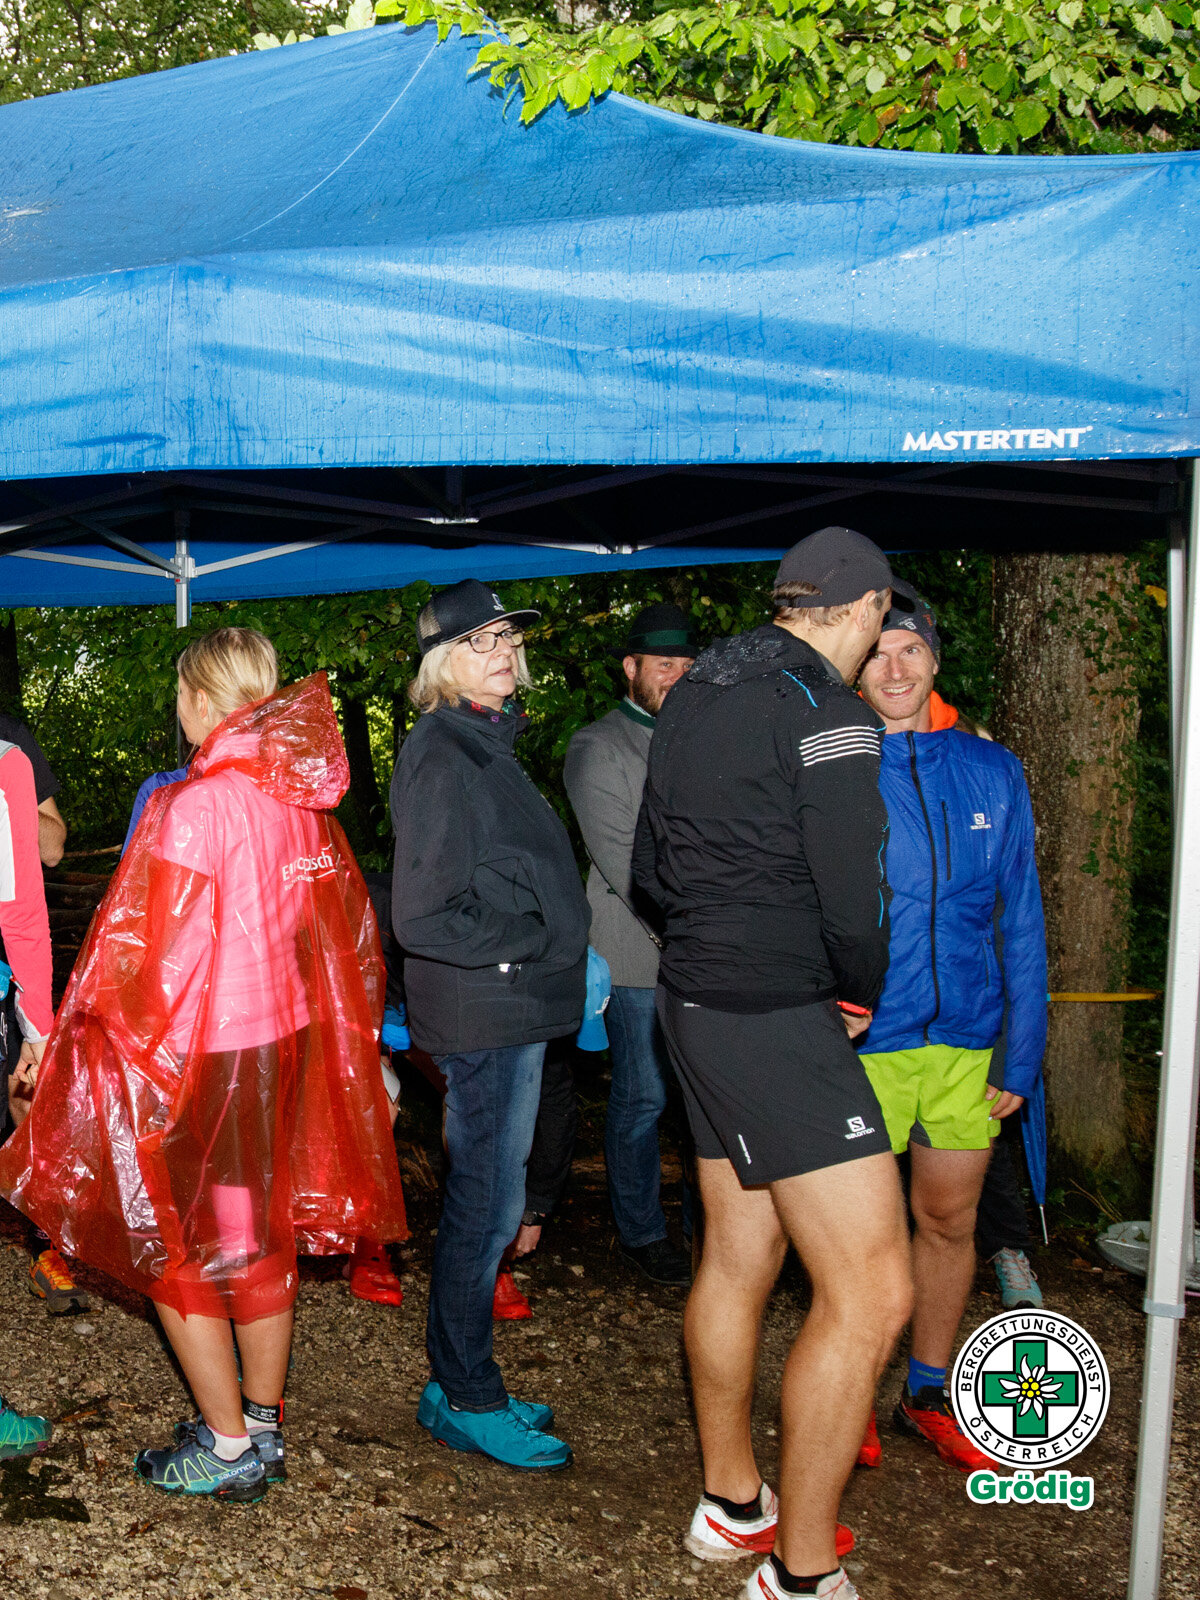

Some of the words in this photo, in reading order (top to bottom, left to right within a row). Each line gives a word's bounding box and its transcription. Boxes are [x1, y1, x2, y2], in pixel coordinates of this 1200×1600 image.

[902, 427, 1088, 451] MASTERTENT
[844, 1127, 875, 1140] salomon
[218, 1460, 257, 1481] salomon
